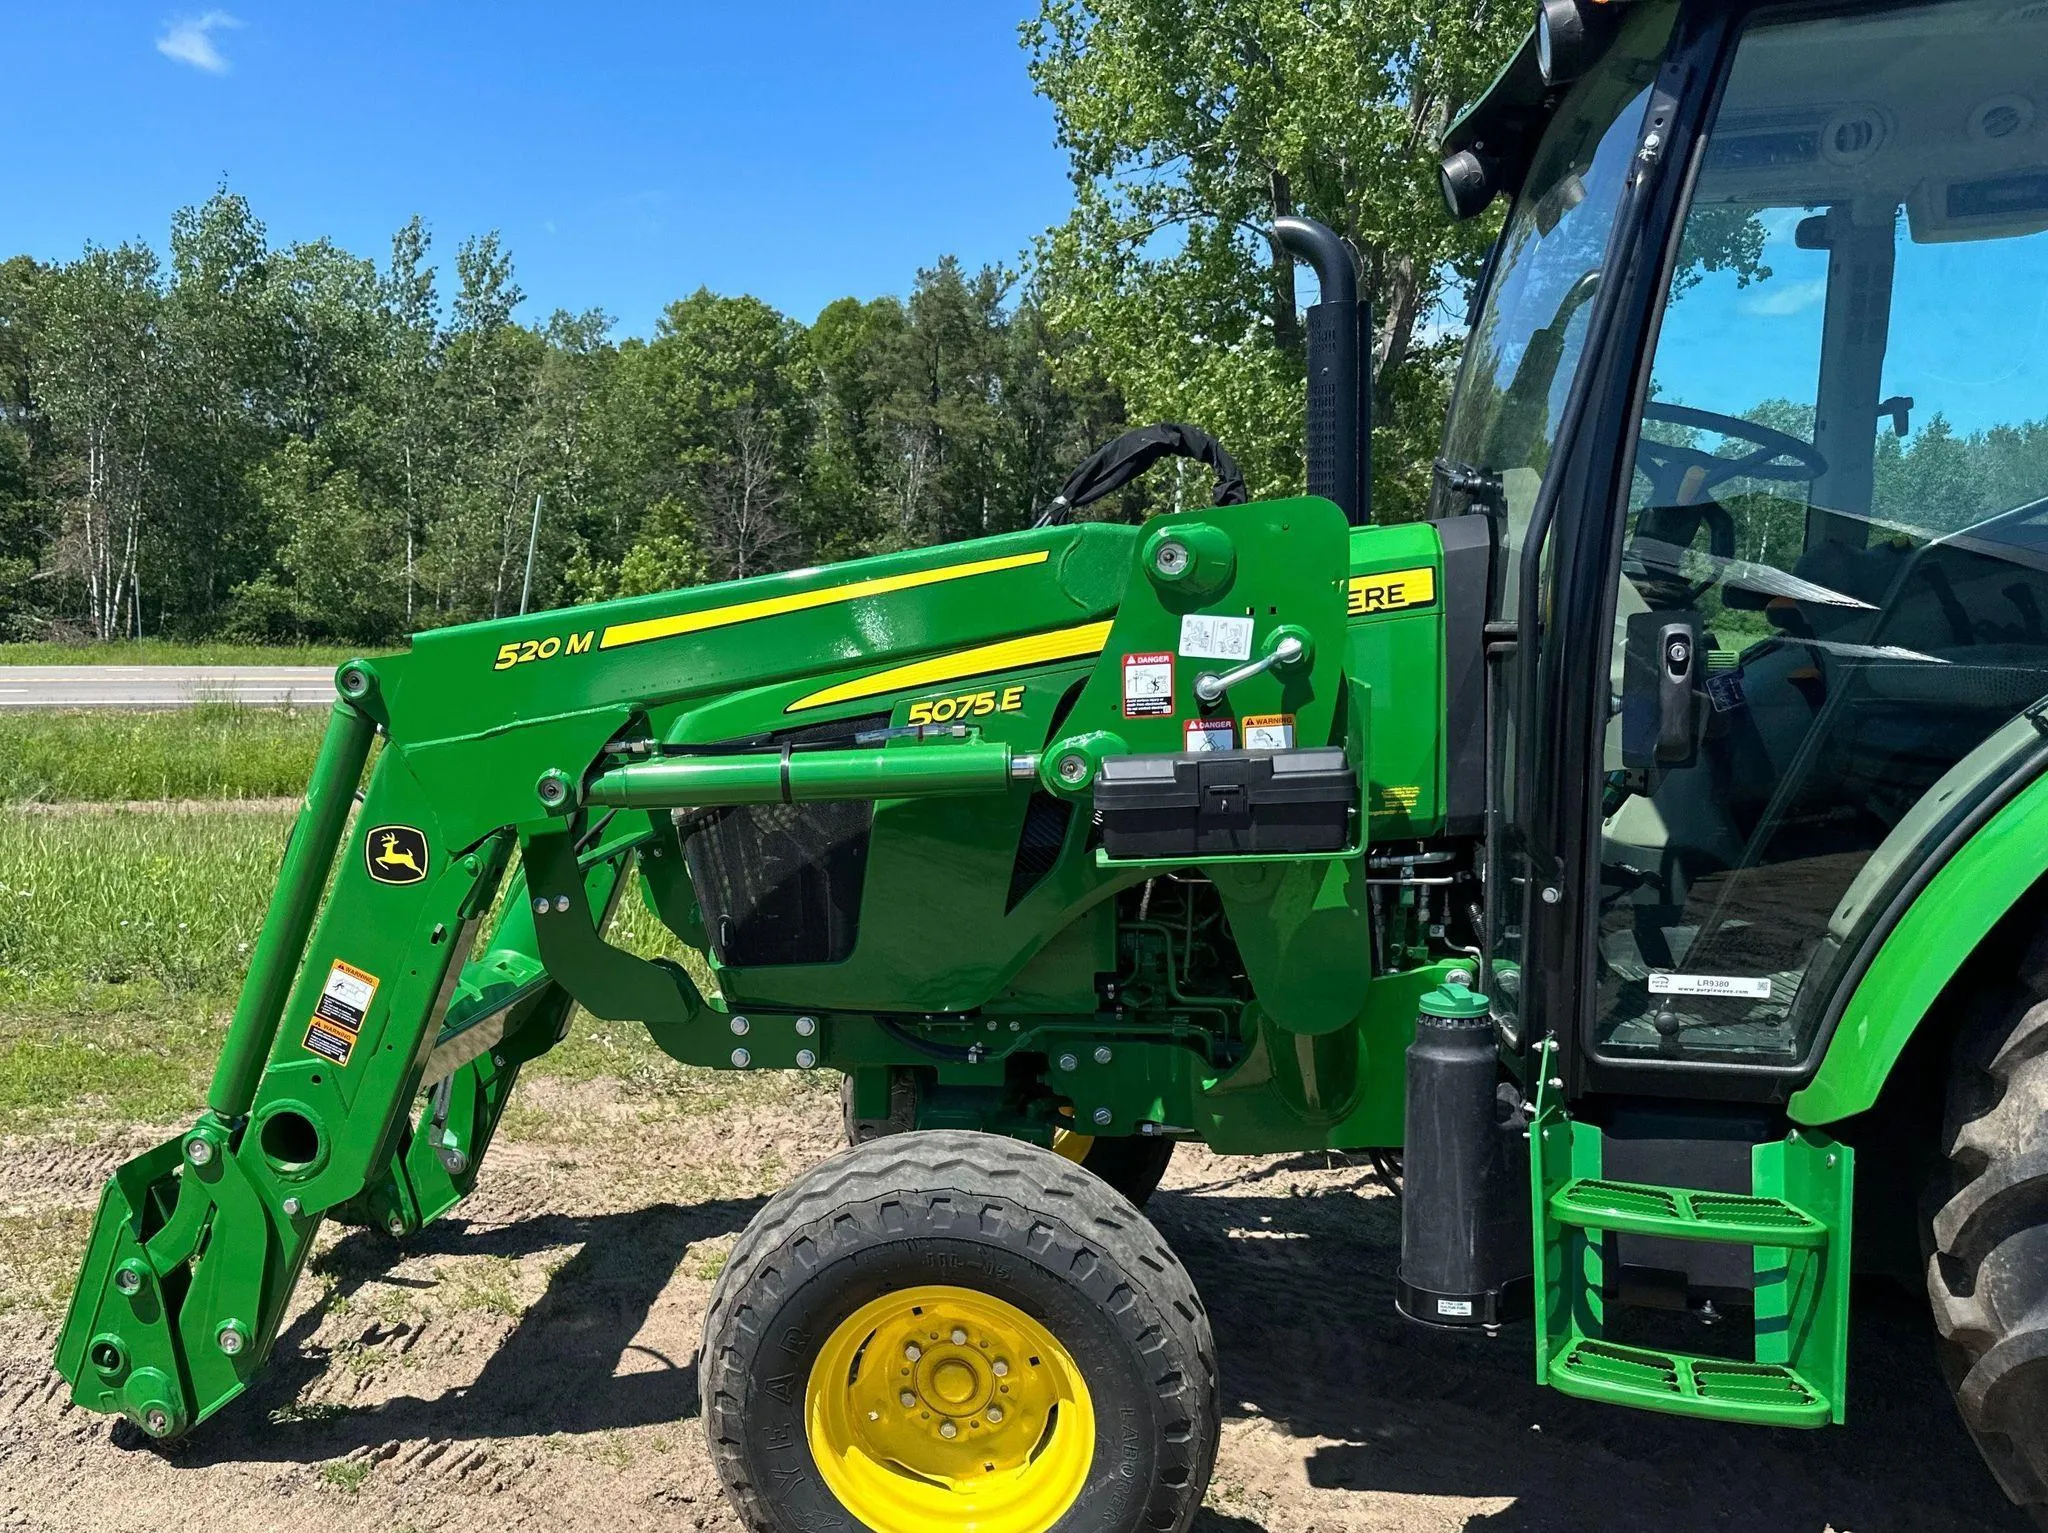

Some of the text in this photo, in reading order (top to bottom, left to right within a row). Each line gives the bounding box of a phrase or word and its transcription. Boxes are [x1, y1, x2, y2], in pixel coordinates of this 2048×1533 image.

[493, 630, 596, 671] 520 M
[1137, 655, 1170, 664] DANGER
[907, 685, 1026, 727] 5075 E
[1199, 720, 1232, 730] DANGER
[1256, 716, 1293, 726] WARNING
[345, 966, 373, 984] WARNING
[1697, 979, 1730, 988] LR9380
[323, 1024, 352, 1041] WARNING
[1103, 1405, 1139, 1524] LABORER
